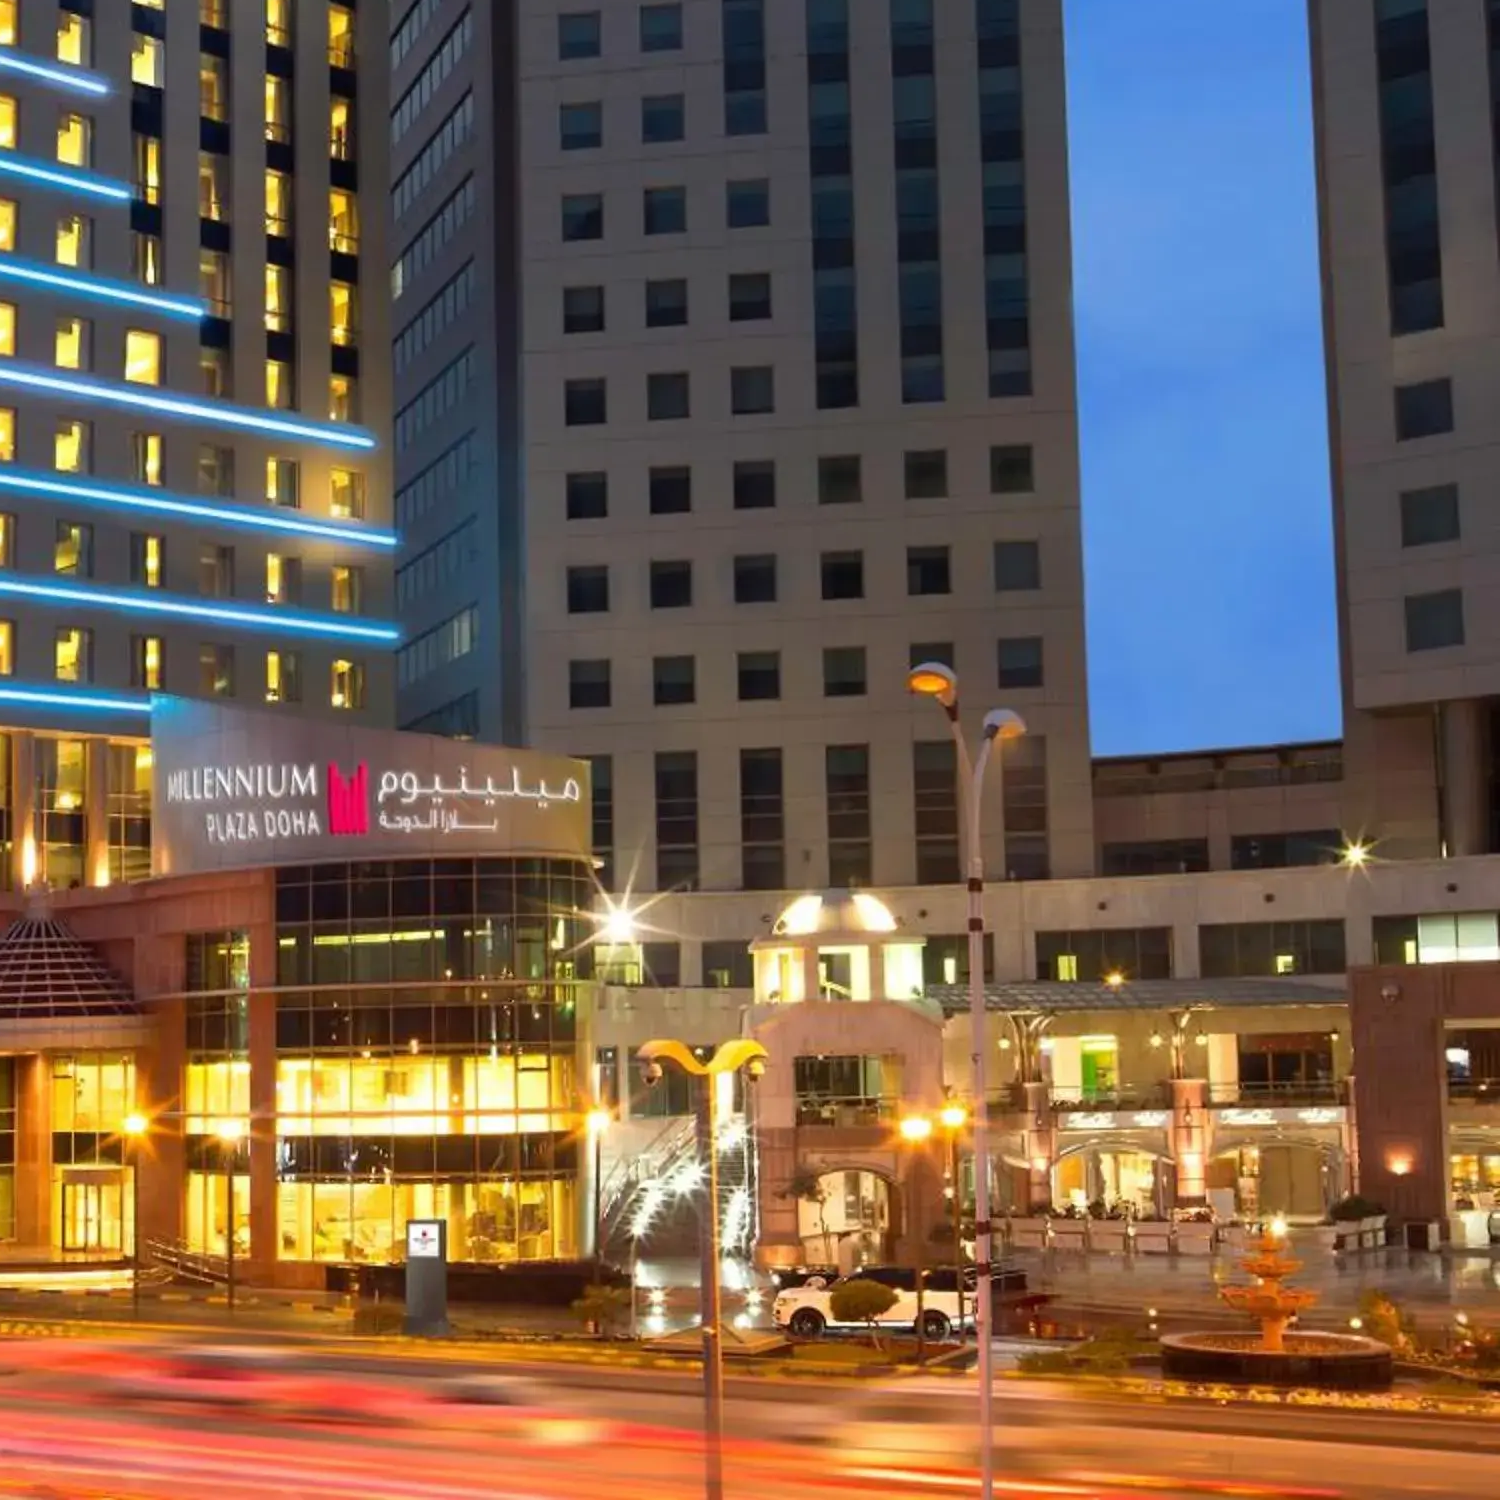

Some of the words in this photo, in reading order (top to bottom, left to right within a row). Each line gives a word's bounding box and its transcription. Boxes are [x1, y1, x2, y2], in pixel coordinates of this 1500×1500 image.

[167, 763, 318, 803] MILLENNIUM
[377, 765, 582, 809] ميلينيوم
[206, 810, 260, 842] PLAZA
[265, 810, 321, 838] DOHA
[379, 808, 438, 832] الدوحة
